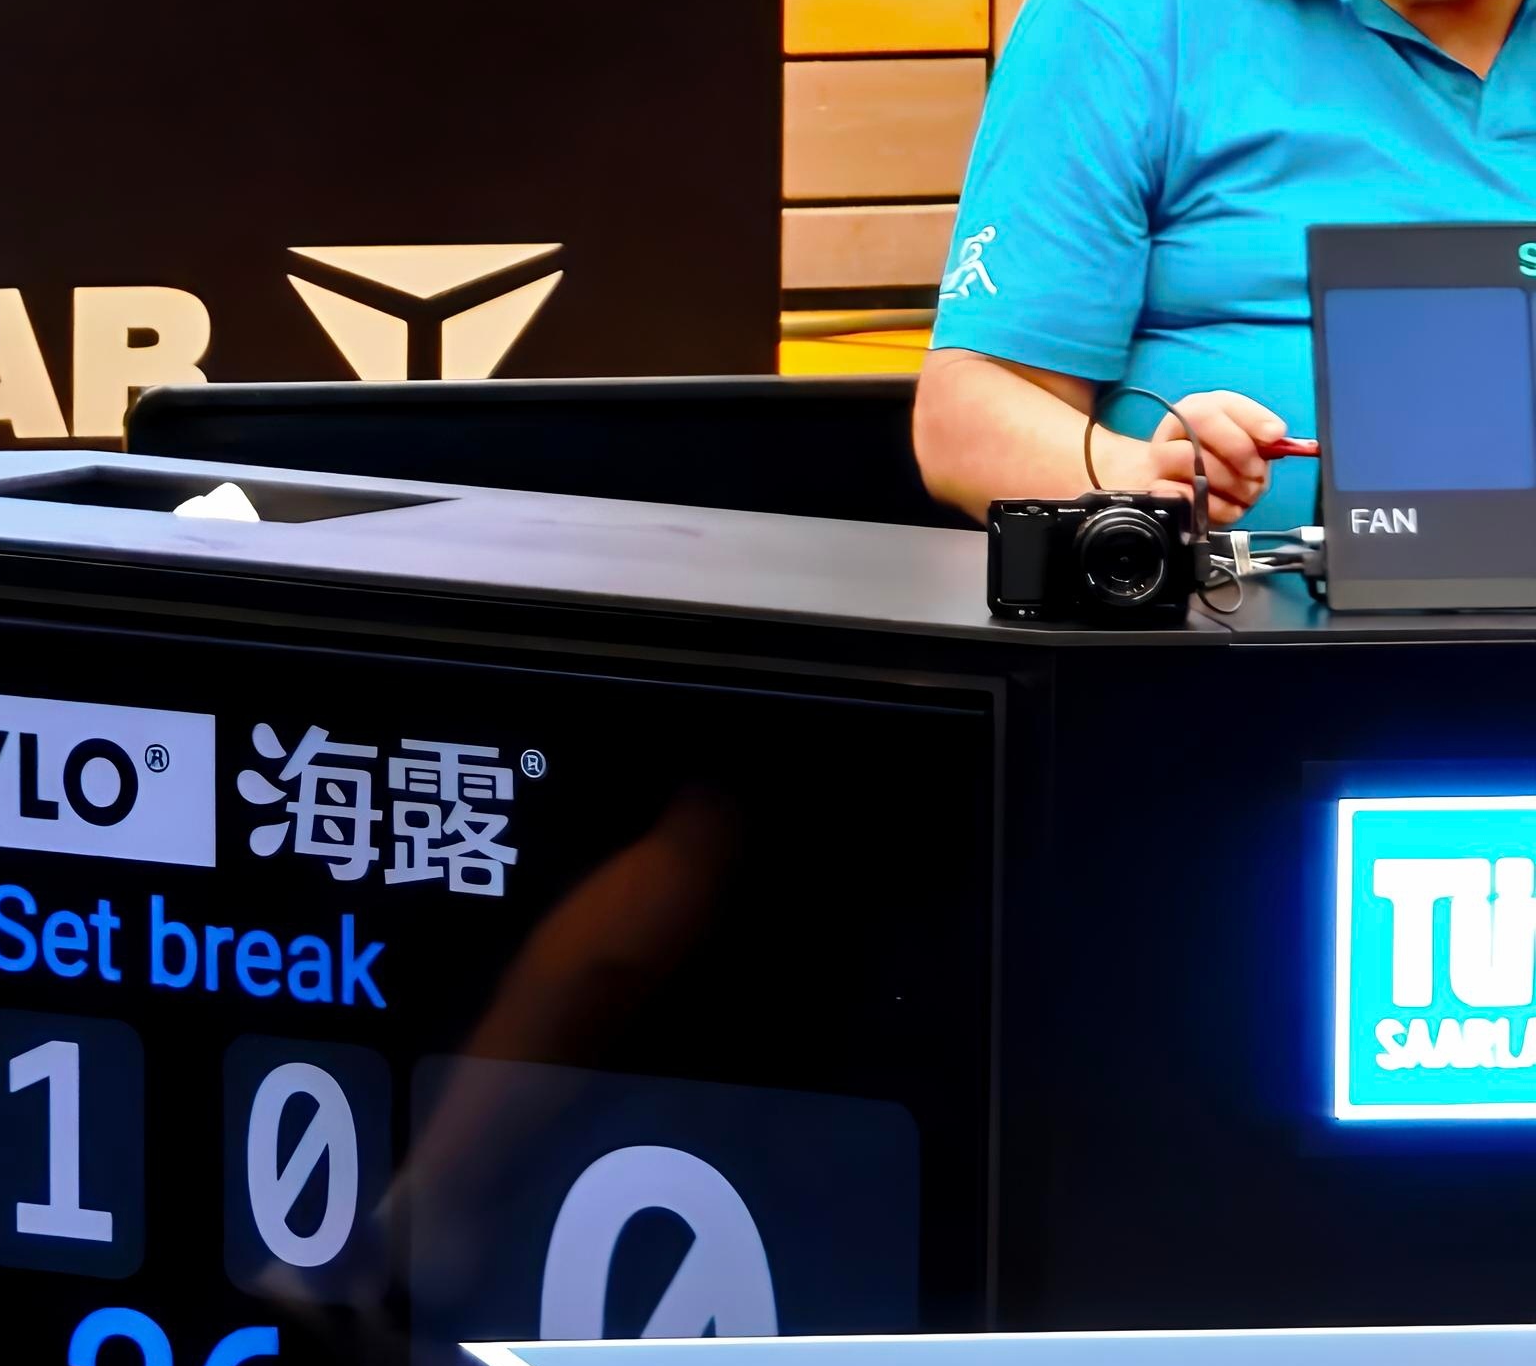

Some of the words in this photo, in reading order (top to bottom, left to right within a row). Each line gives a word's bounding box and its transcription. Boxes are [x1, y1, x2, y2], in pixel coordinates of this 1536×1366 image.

[1350, 507, 1418, 534] FAN
[151, 895, 388, 1010] break
[9, 1040, 114, 1243] 1
[248, 1062, 359, 1268] 0
